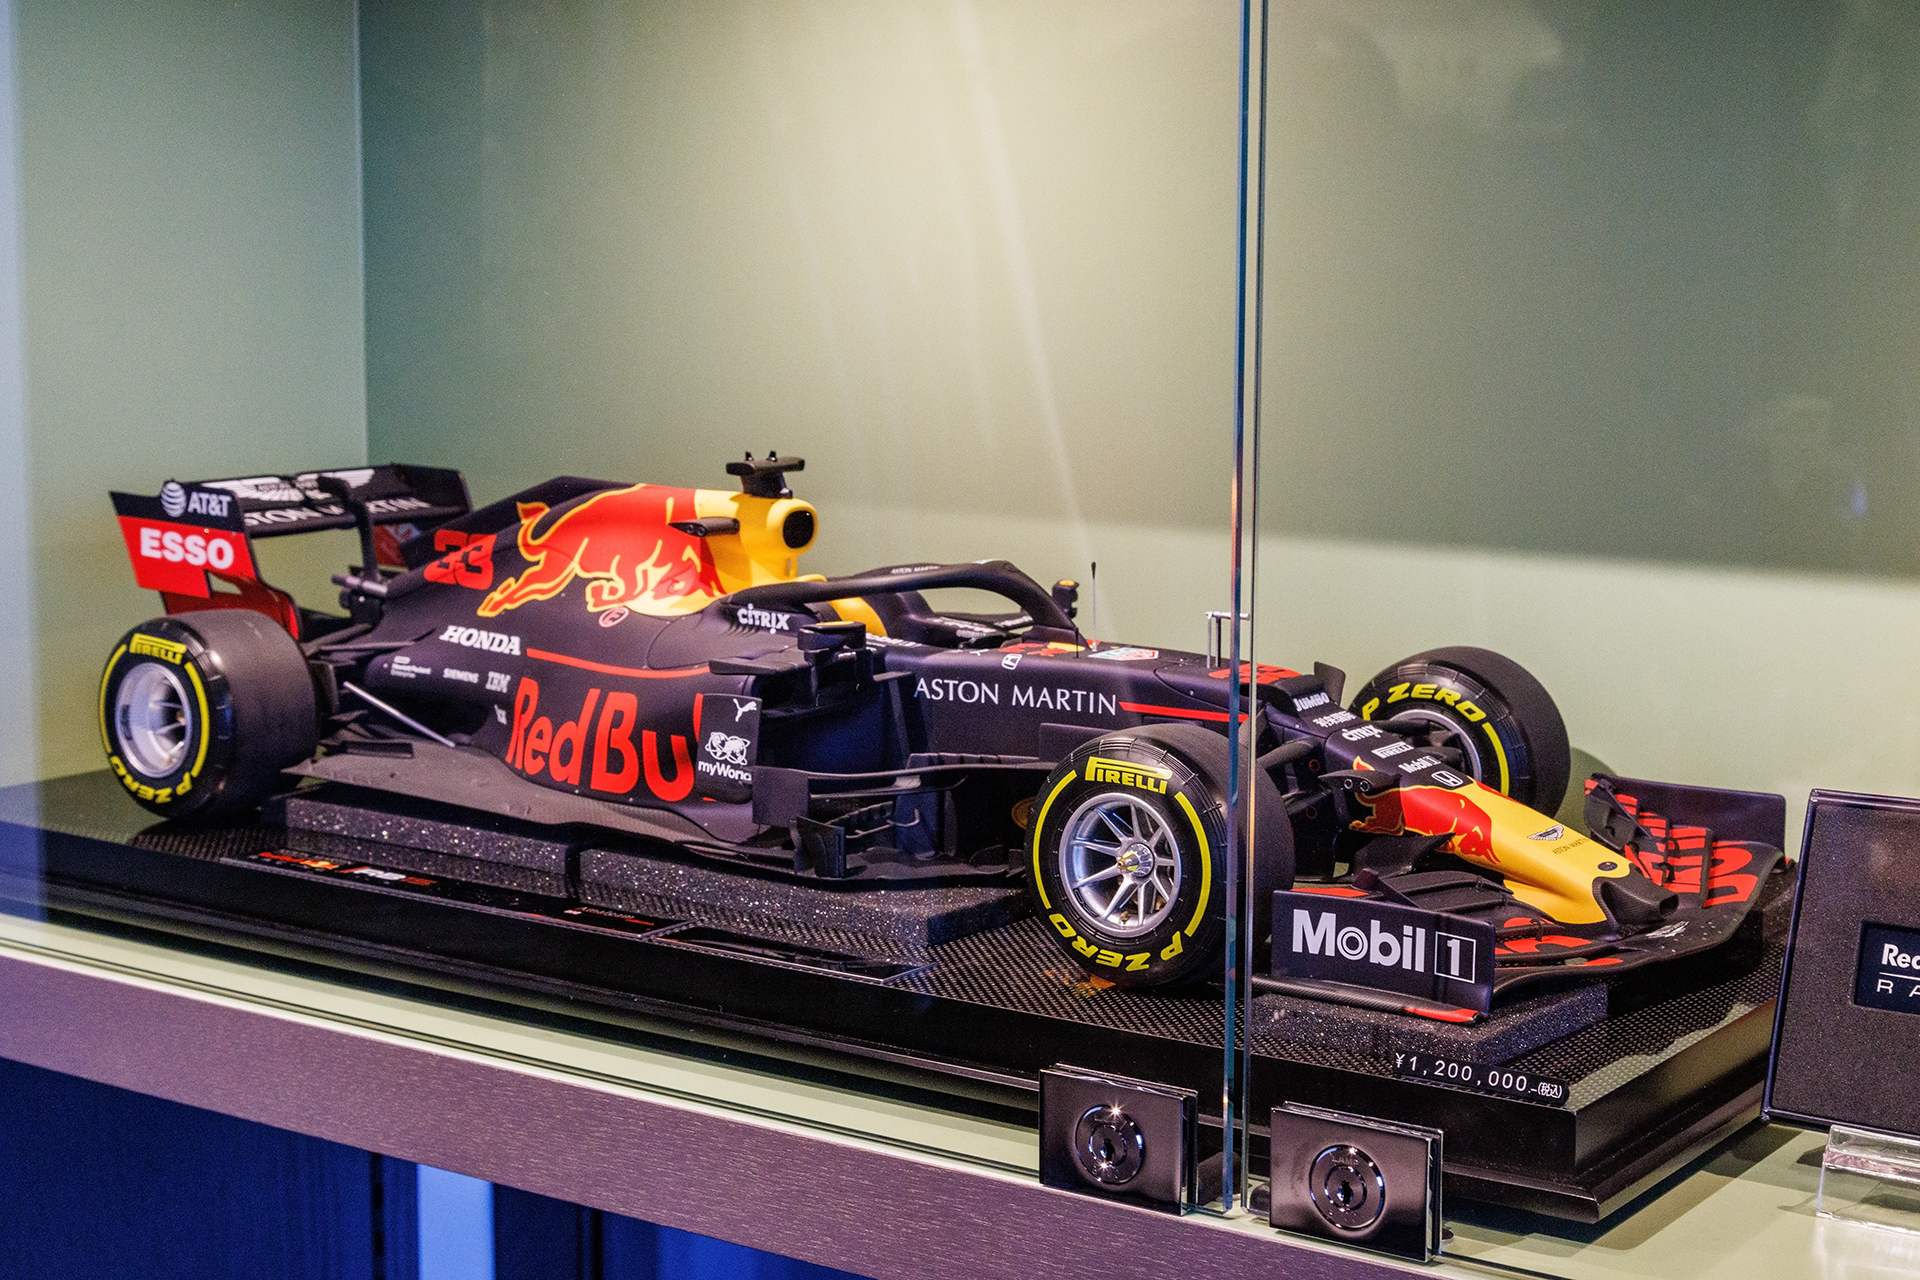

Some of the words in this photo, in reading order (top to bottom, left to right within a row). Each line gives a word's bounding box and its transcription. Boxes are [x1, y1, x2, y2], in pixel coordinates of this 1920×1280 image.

[188, 491, 232, 517] AT&T
[140, 527, 234, 569] ESSO
[129, 633, 187, 665] PIRELLI
[439, 625, 521, 655] HONDA
[485, 671, 511, 693] IBM
[914, 677, 998, 705] ASTON
[1011, 684, 1117, 716] MARTIN
[1293, 692, 1330, 711] JUMBO
[1362, 697, 1380, 721] P
[1387, 682, 1487, 723] ZERO
[1085, 756, 1172, 796] PIRELLI
[1049, 912, 1151, 973] ZERO
[1160, 930, 1184, 961] P
[1292, 909, 1426, 973] Mobil
